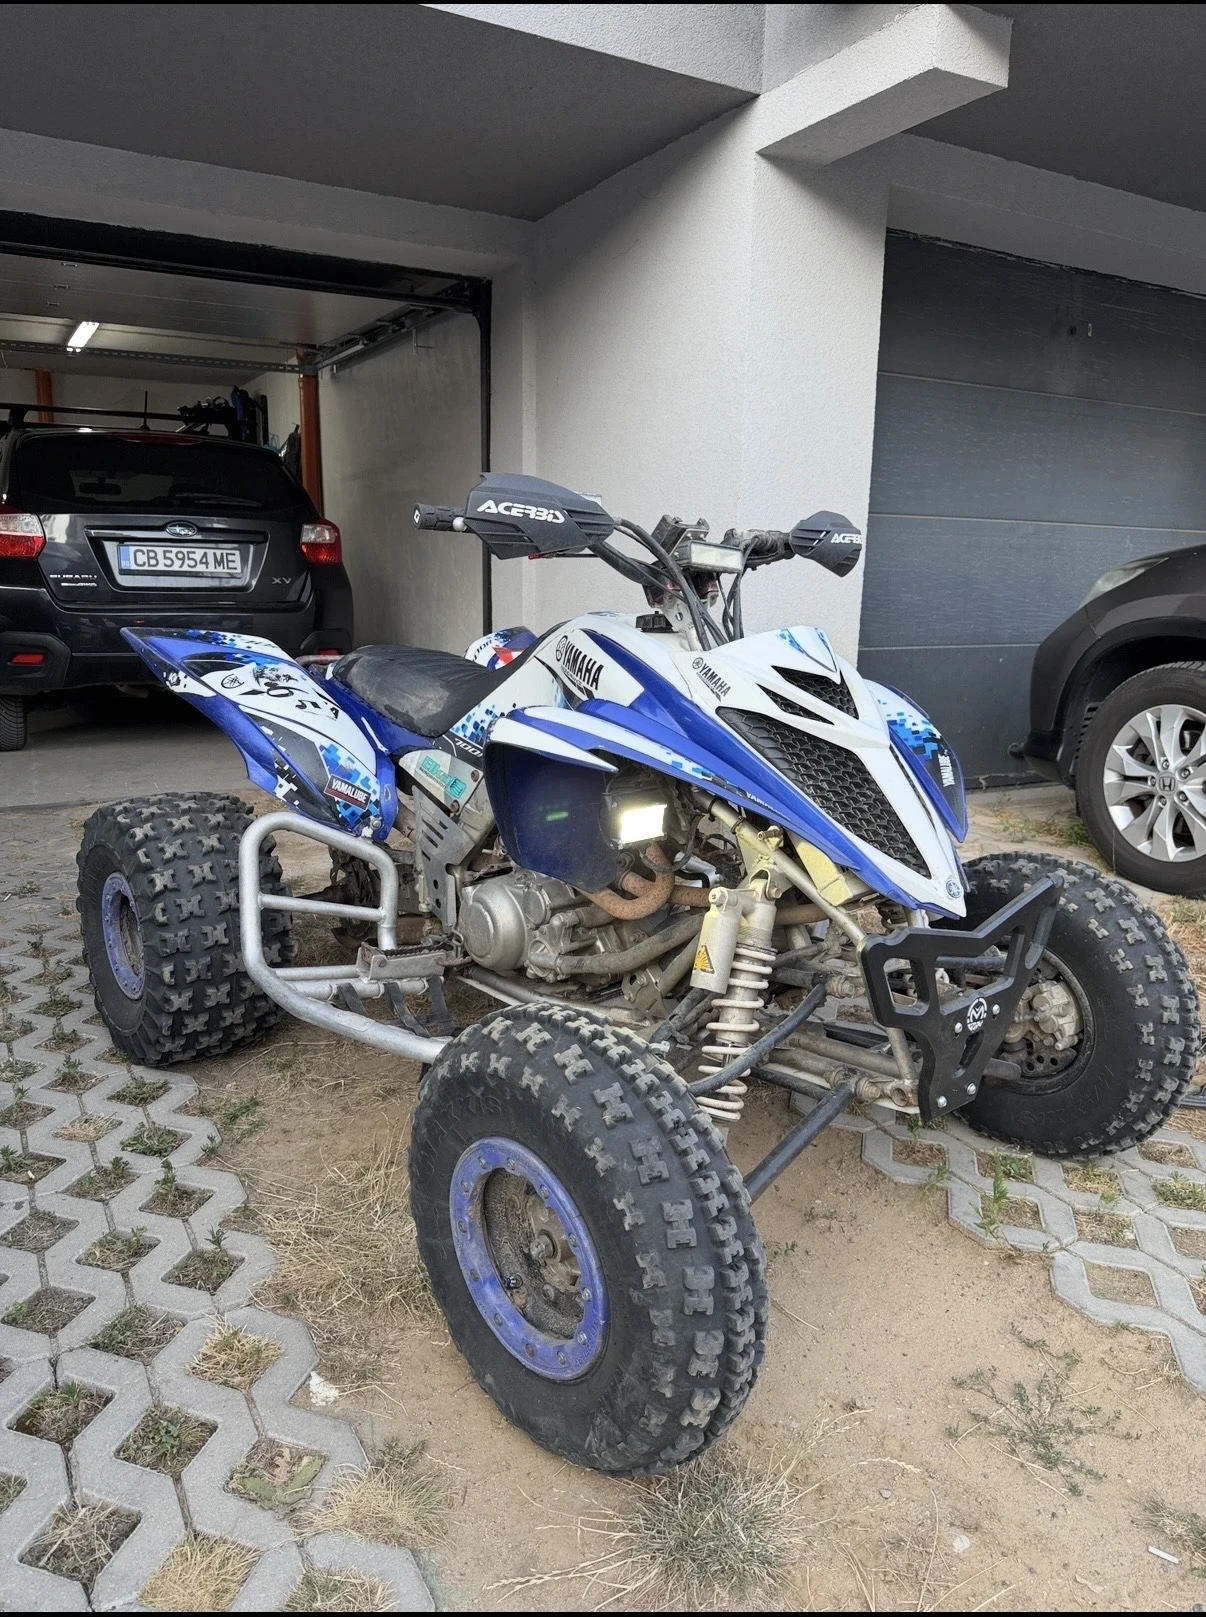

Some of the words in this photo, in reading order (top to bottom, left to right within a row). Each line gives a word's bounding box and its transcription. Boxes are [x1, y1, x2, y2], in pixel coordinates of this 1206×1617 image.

[477, 499, 566, 524] ACERBIS
[830, 533, 863, 544] ACERB
[133, 548, 159, 568] CB
[163, 550, 210, 569] 5954
[213, 552, 237, 570] ME
[271, 576, 292, 585] XV
[562, 640, 604, 691] YAMAHA
[699, 662, 731, 697] YAMAHA
[454, 738, 484, 758] 700
[331, 778, 369, 804] YAMALUBE
